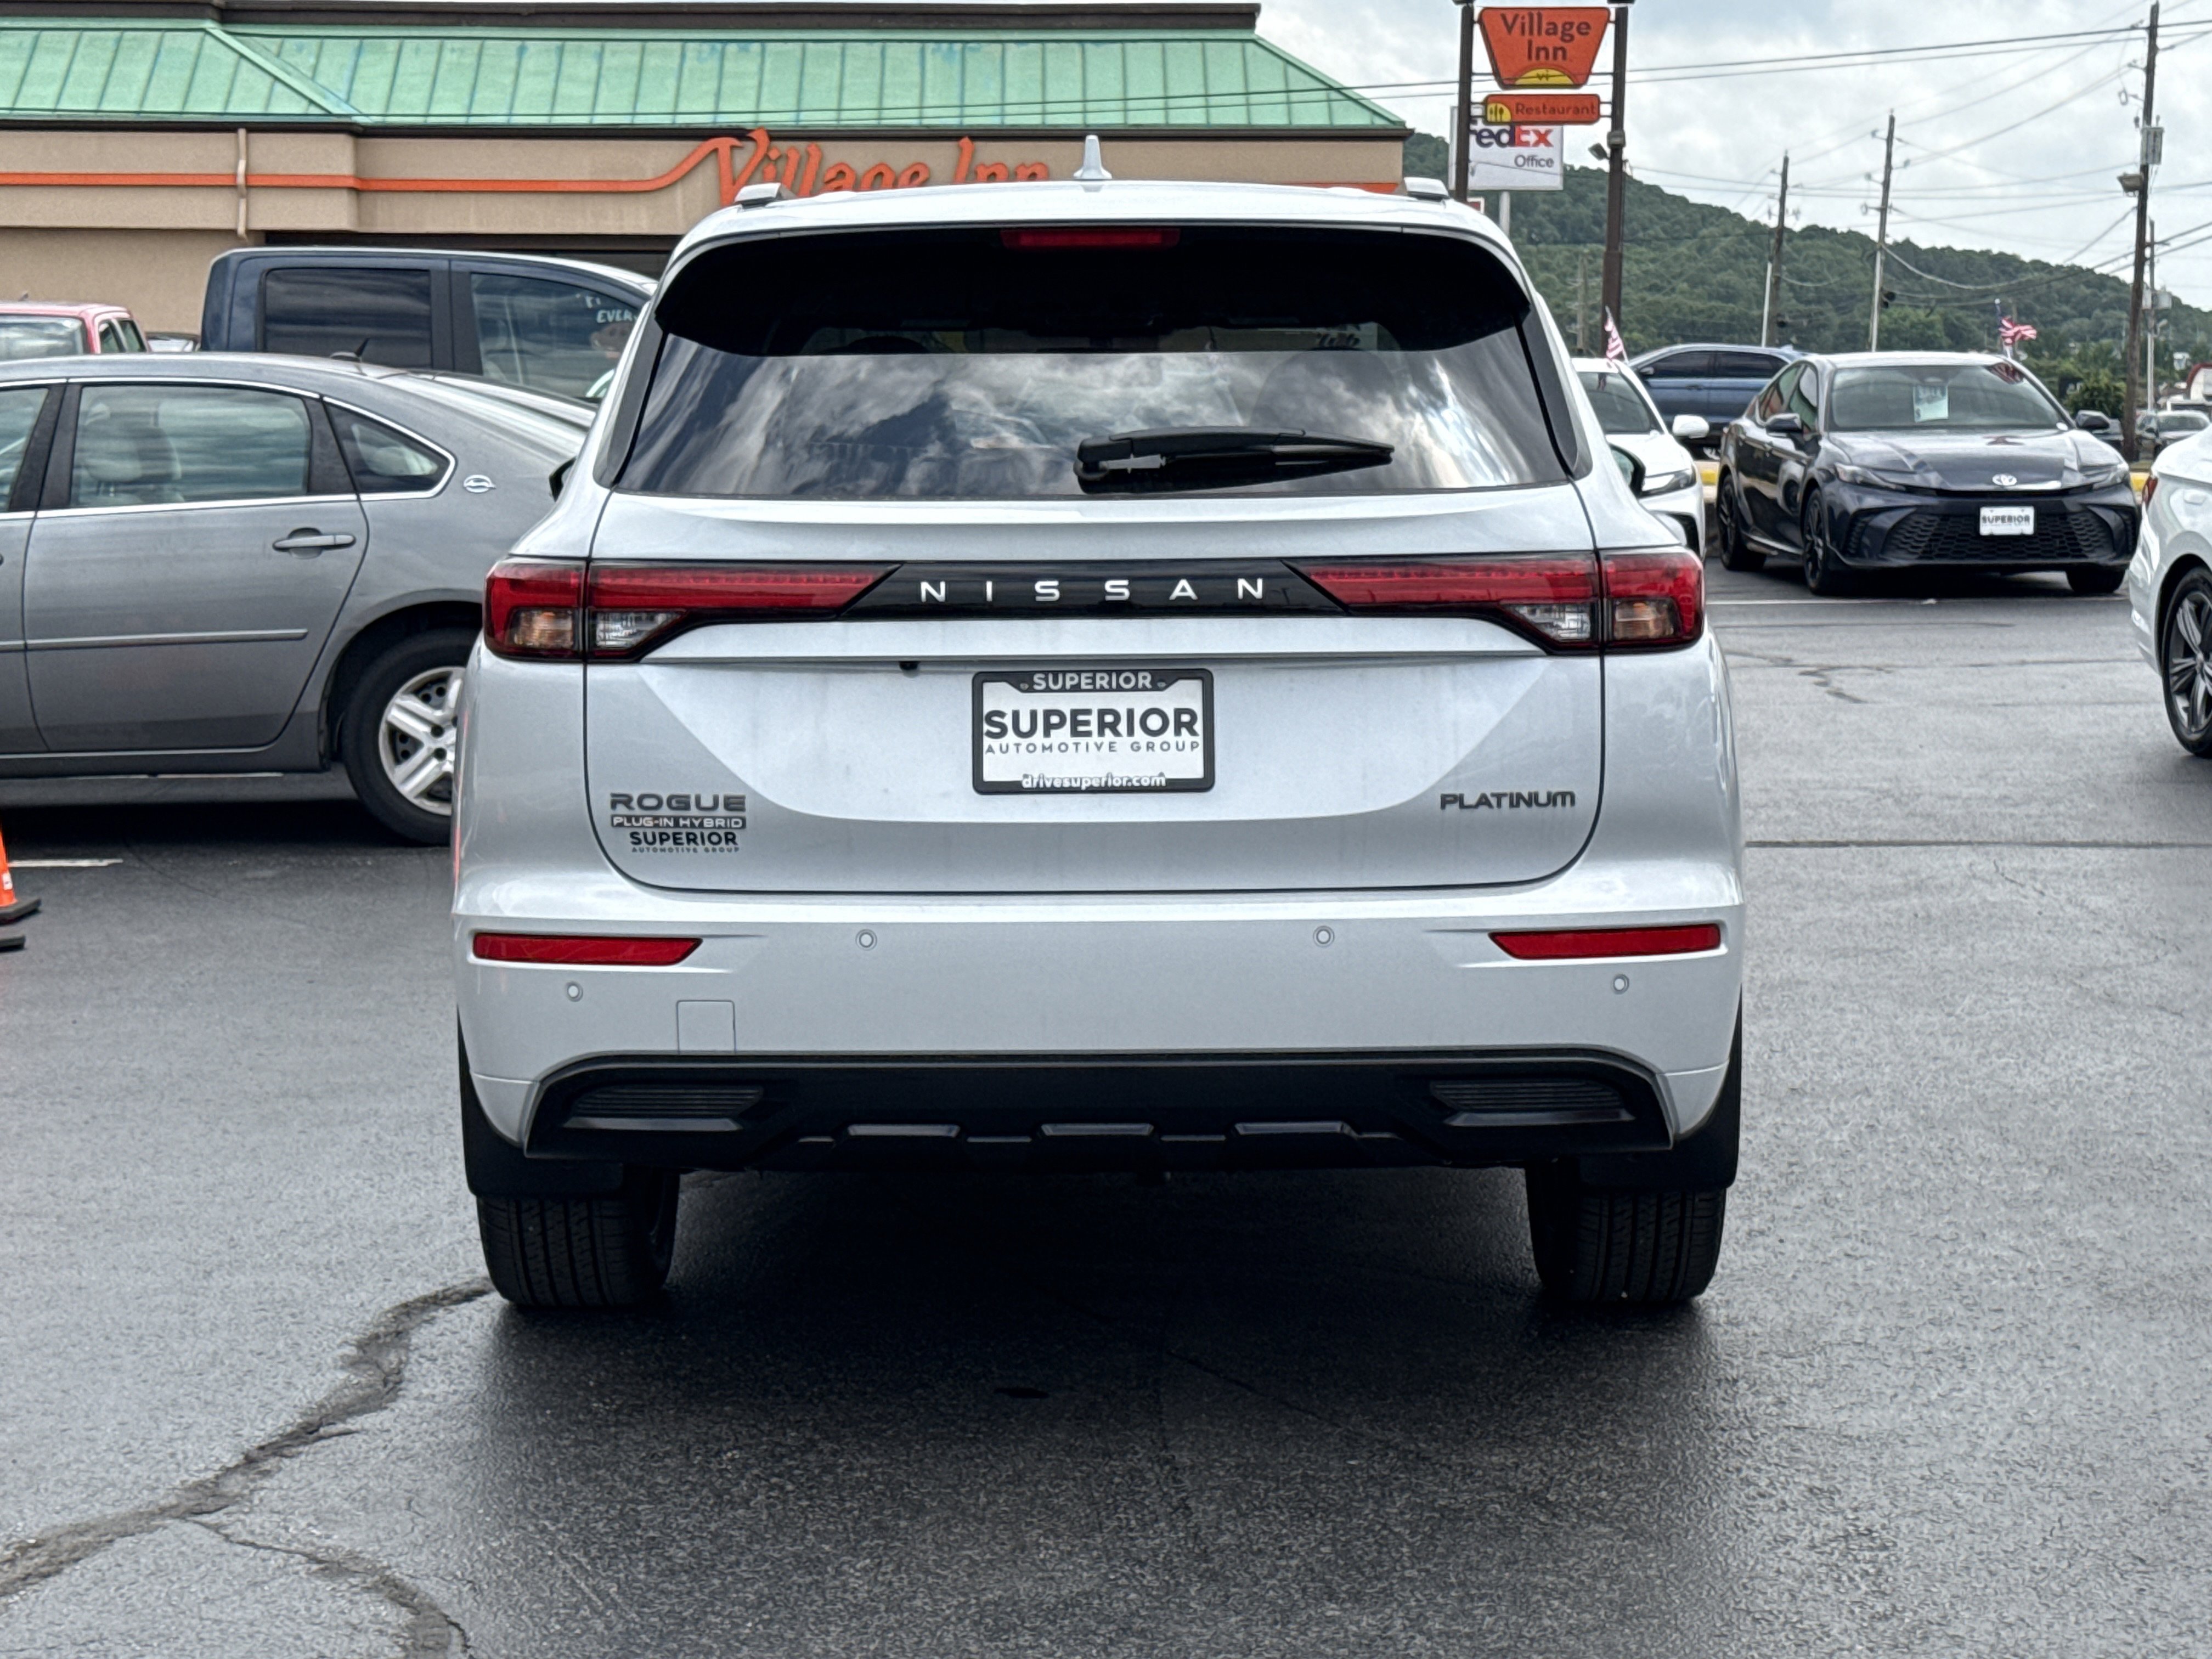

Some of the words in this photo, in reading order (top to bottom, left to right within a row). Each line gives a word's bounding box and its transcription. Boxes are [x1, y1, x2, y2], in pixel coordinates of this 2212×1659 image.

[1500, 12, 1592, 43] Village
[1528, 40, 1567, 60] Inn
[1515, 102, 1596, 115] Restaurant
[1514, 155, 1554, 167] Office
[1982, 515, 2030, 524] SUPERIOR
[919, 578, 1265, 603] NISSAN
[1033, 672, 1153, 690] SUPERIOR
[984, 708, 1200, 739] SUPERIOR
[985, 741, 1118, 755] AUTOMOTIVE
[1130, 740, 1200, 753] GROUP
[1022, 773, 1166, 791] drivesuperior.com
[610, 793, 747, 812] ROGUE
[1440, 791, 1576, 810] PLATINUM
[613, 816, 674, 827] PLUG-IN
[679, 817, 743, 828] HYBRID
[630, 831, 739, 847] SUPERIOR
